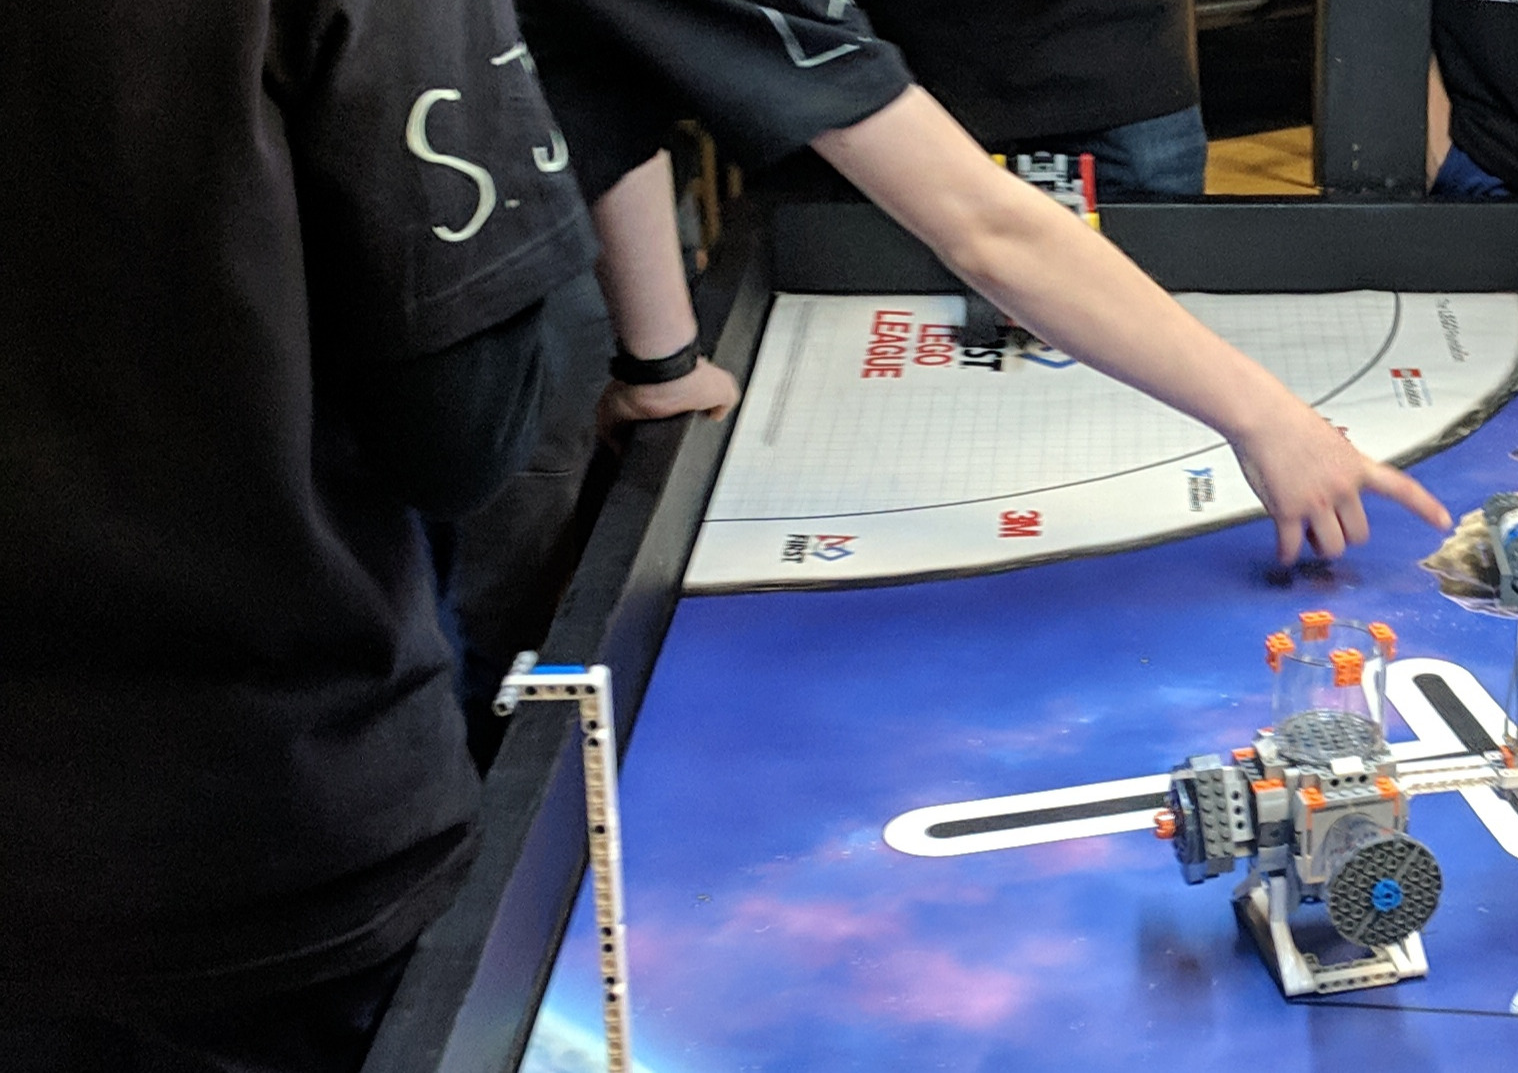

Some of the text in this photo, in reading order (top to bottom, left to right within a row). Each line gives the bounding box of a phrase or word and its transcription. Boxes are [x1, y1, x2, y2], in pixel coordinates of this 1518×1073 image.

[860, 310, 914, 379] LEAGUE
[912, 323, 956, 367] LEGO
[998, 510, 1043, 538] 3M
[781, 534, 810, 564] FIRST
